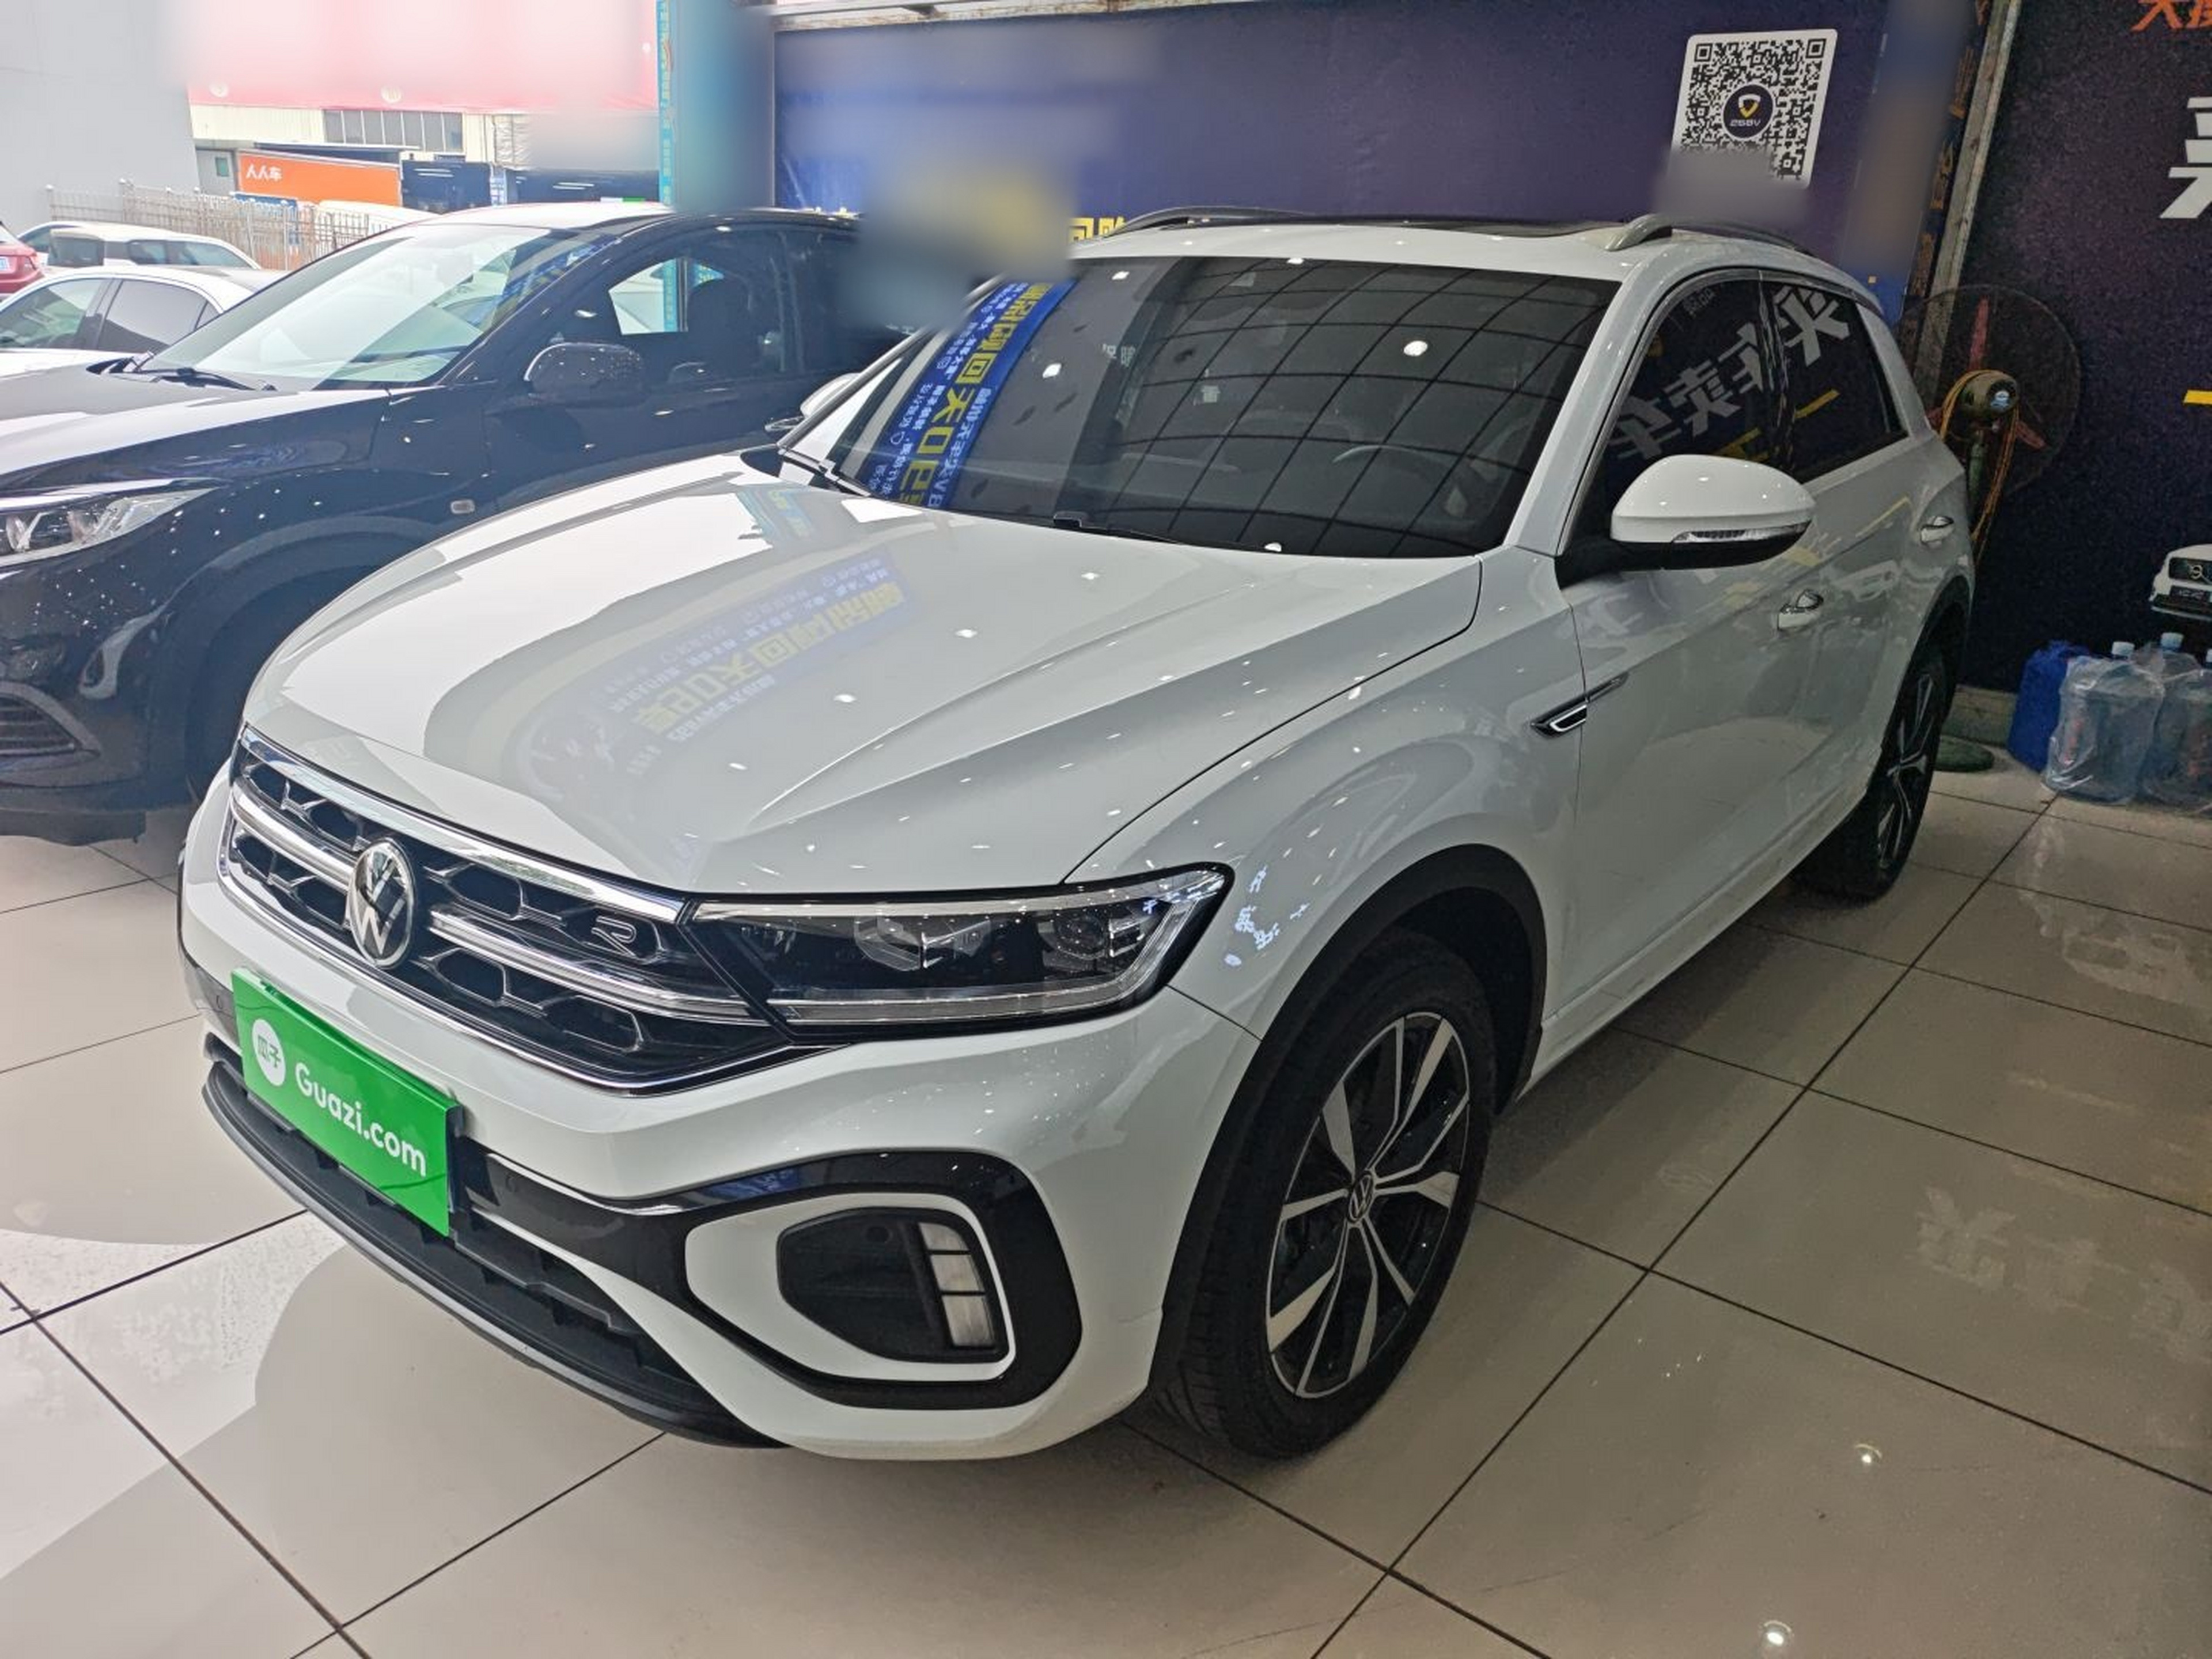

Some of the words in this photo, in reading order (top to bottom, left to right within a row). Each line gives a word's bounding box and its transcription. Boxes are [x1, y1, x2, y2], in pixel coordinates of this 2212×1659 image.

[245, 164, 282, 181] 人人车
[257, 1035, 282, 1069] 瓜子
[295, 1062, 426, 1177] Guazi.com
